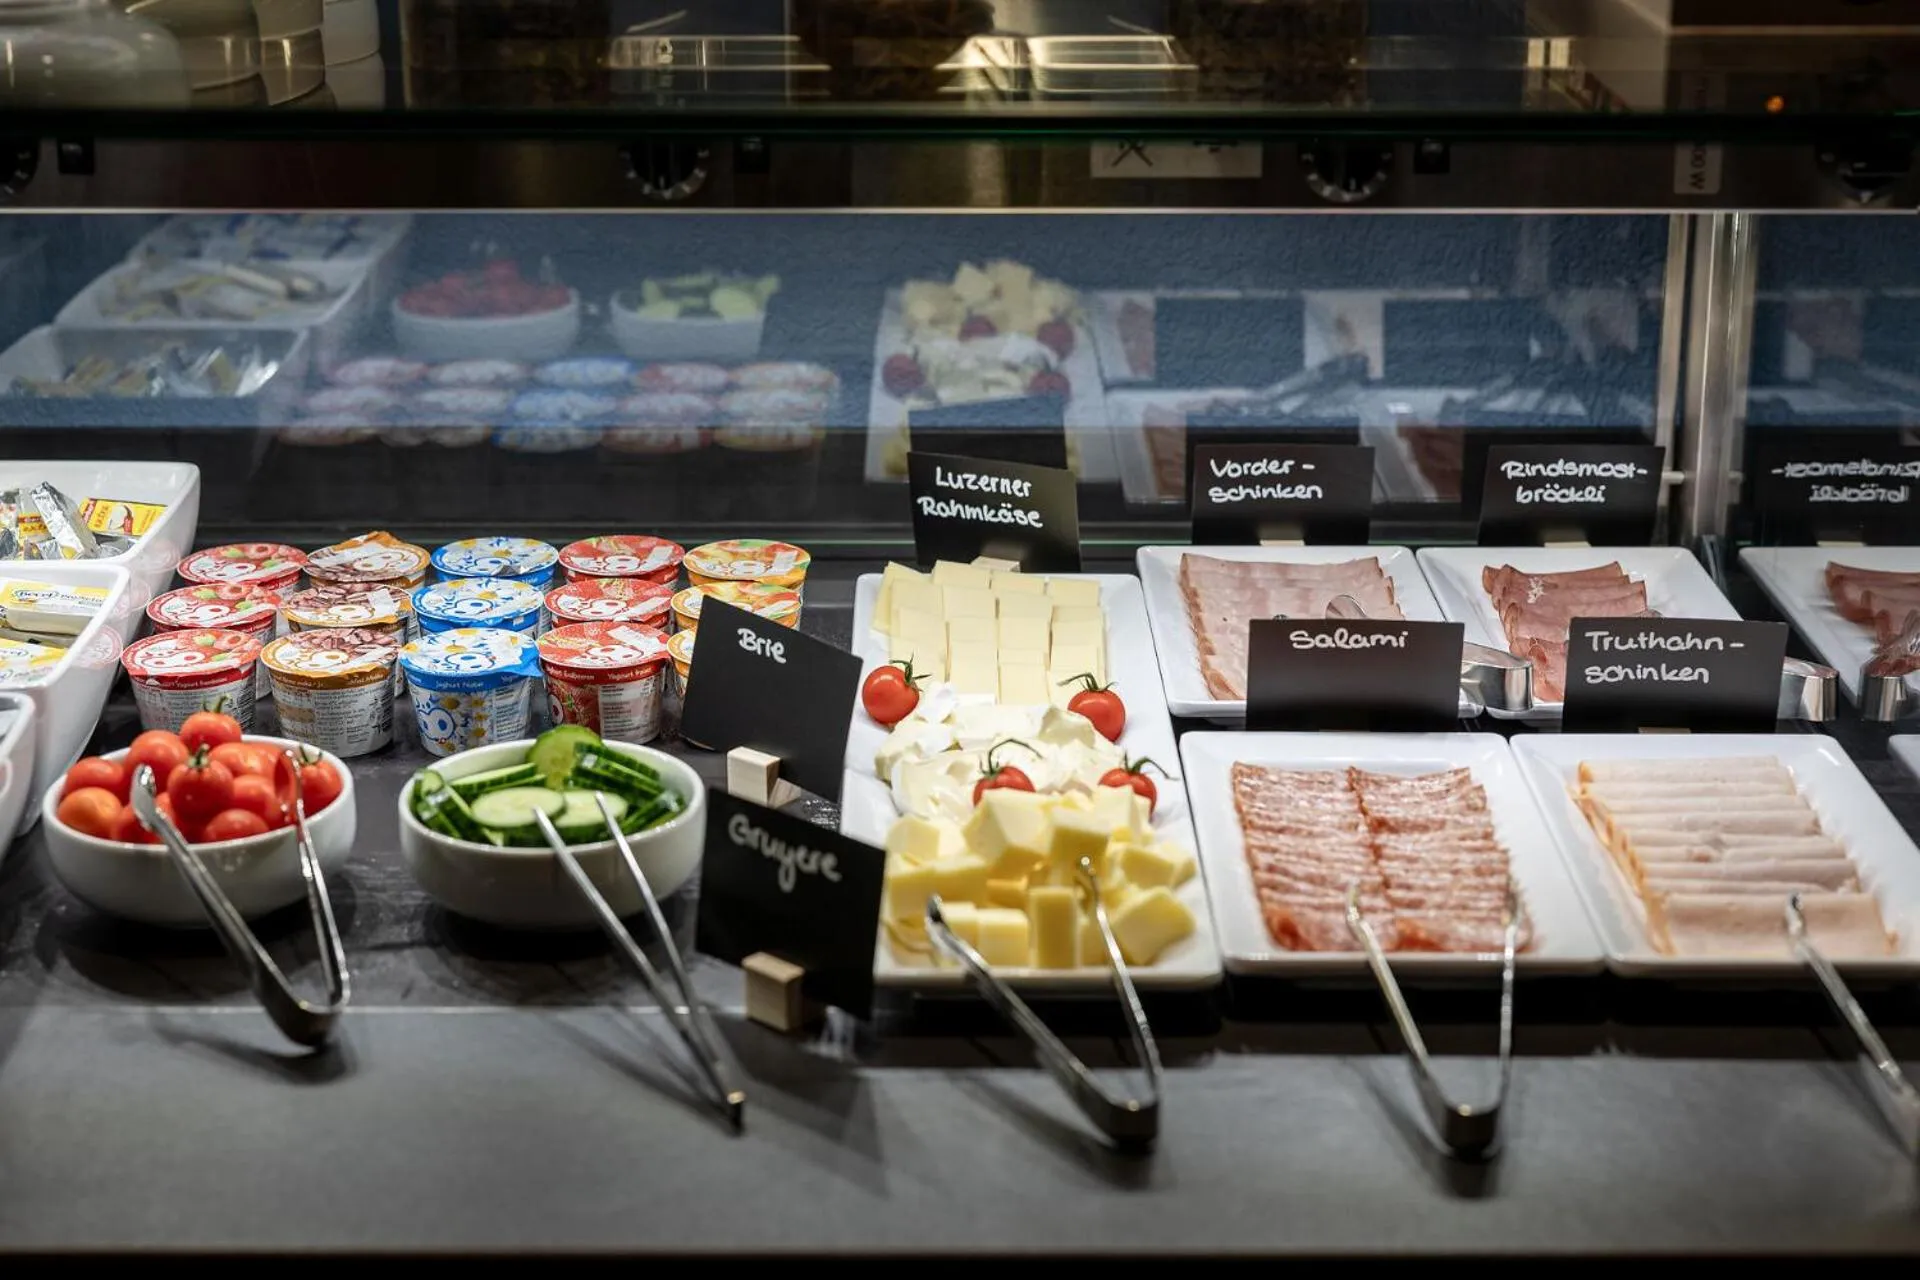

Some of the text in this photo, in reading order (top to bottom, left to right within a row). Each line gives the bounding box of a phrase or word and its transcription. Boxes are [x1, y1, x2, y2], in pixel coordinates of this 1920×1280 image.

[936, 466, 1032, 497] Luzerner
[1208, 483, 1323, 503] schinken
[1516, 483, 1606, 503] bröckli
[917, 496, 1043, 528] Rahmkäse
[737, 627, 787, 664] Brie
[1289, 627, 1409, 649] Salami
[1584, 663, 1709, 684] schinken
